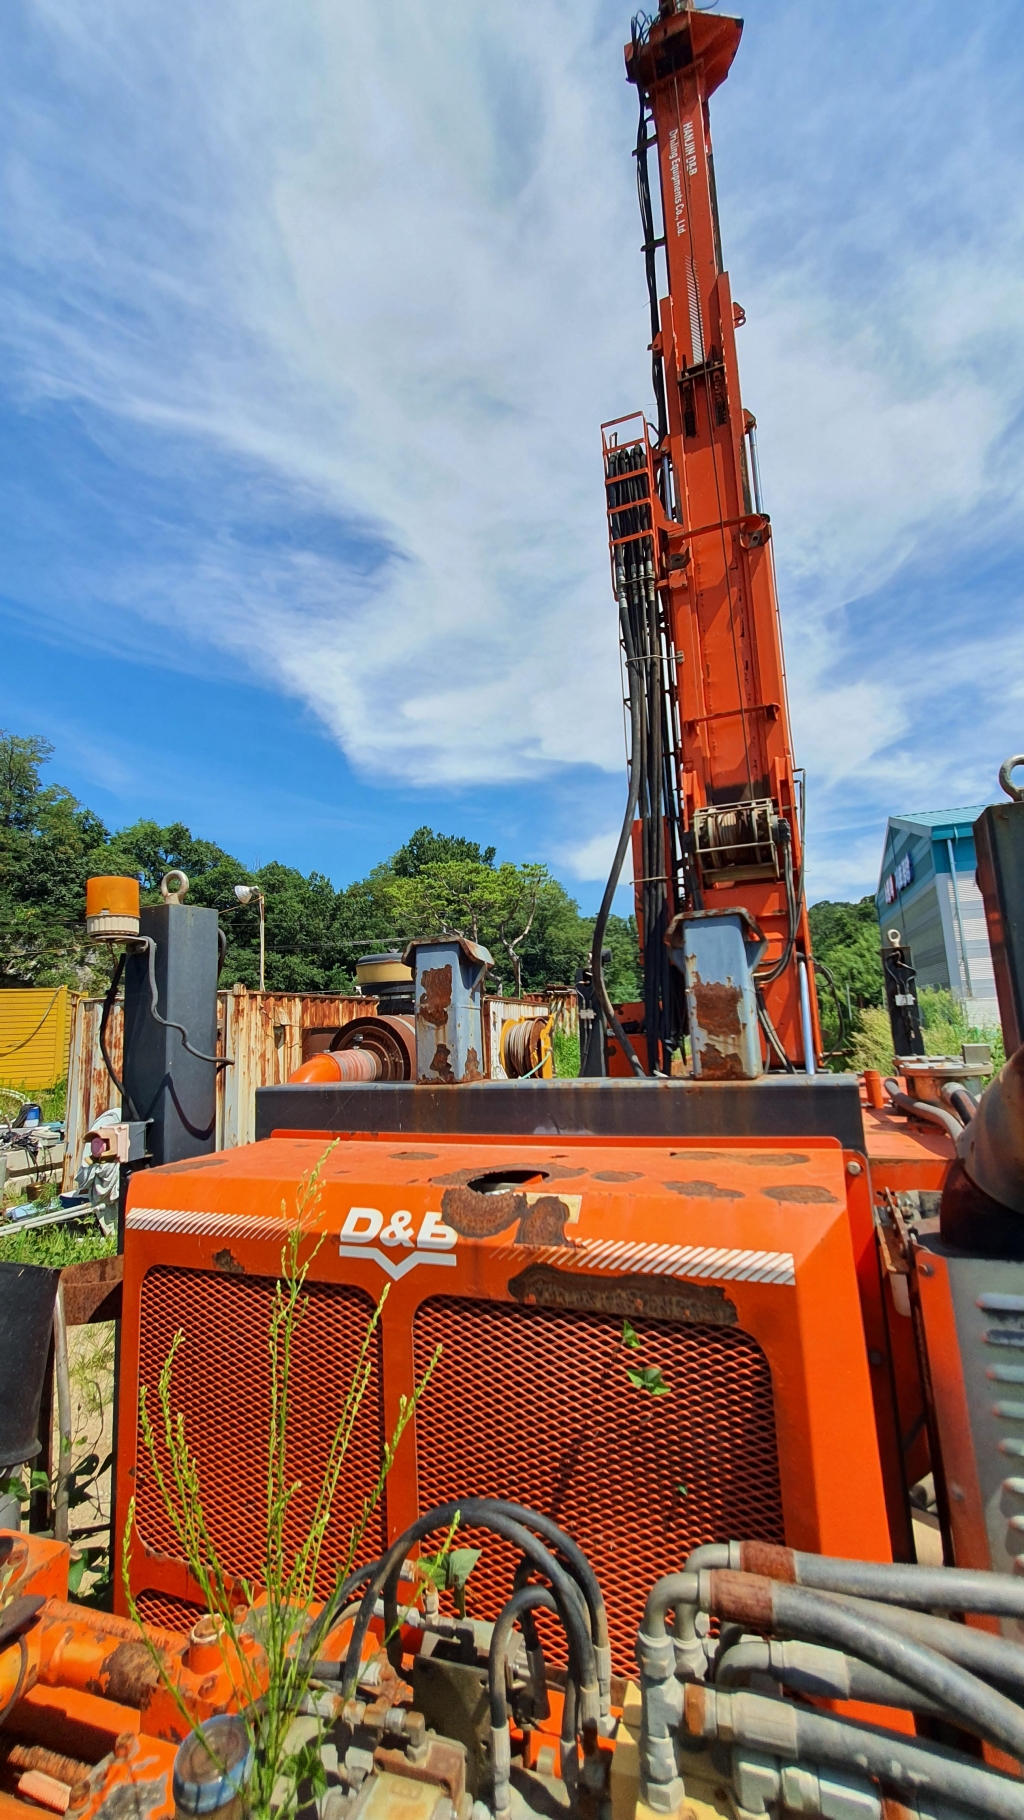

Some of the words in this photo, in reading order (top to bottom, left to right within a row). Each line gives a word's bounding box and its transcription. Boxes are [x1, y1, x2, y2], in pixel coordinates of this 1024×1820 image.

[669, 129, 680, 159] Drilling
[683, 121, 695, 155] HANJIN
[670, 158, 683, 204] Equipments
[686, 156, 698, 176] D&B
[676, 219, 687, 237] Ltd.
